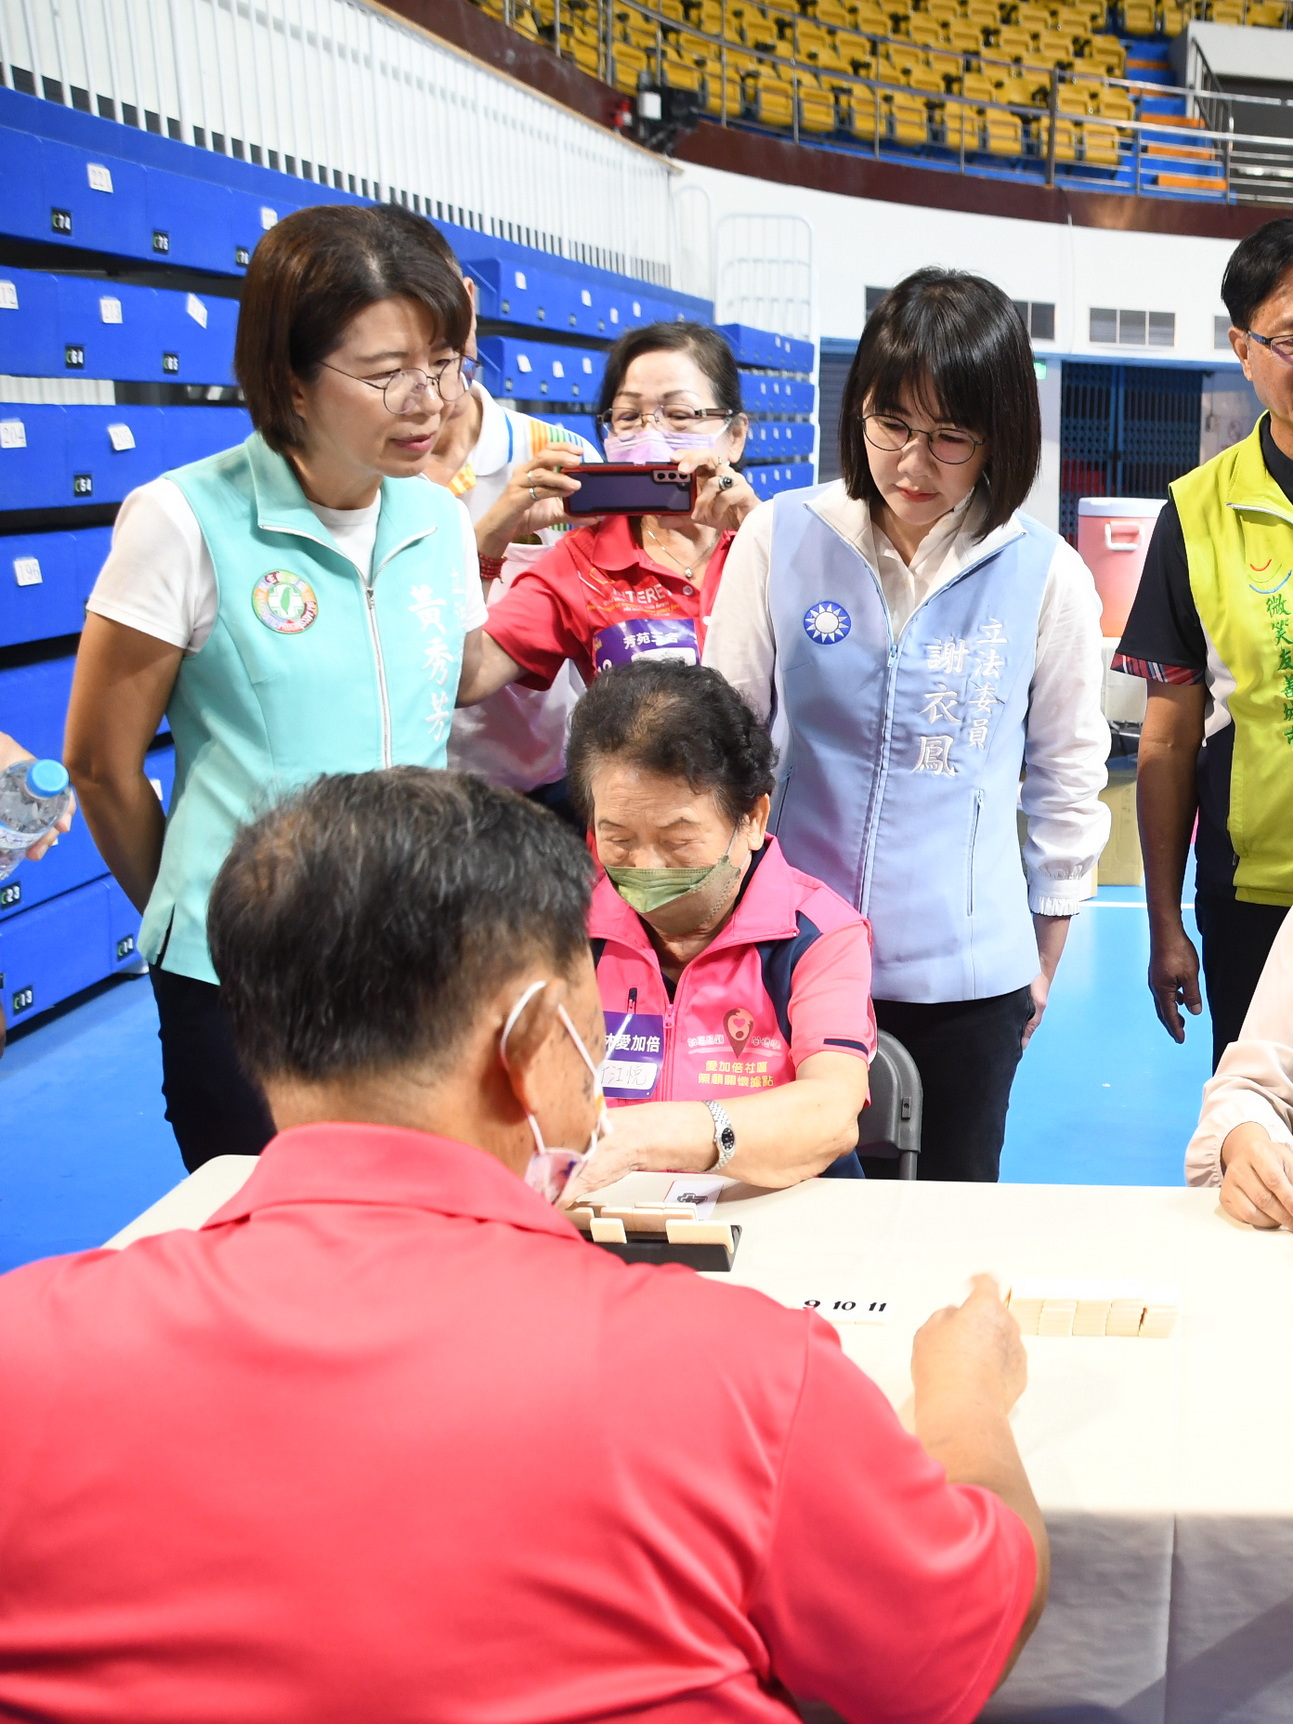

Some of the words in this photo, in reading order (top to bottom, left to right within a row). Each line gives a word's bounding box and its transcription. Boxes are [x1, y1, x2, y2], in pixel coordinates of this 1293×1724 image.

[408, 584, 454, 742] 黃秀芳
[911, 636, 969, 777] 謝衣鳳
[967, 618, 1008, 749] 立法委員
[833, 1300, 856, 1311] 10
[868, 1302, 887, 1312] 11
